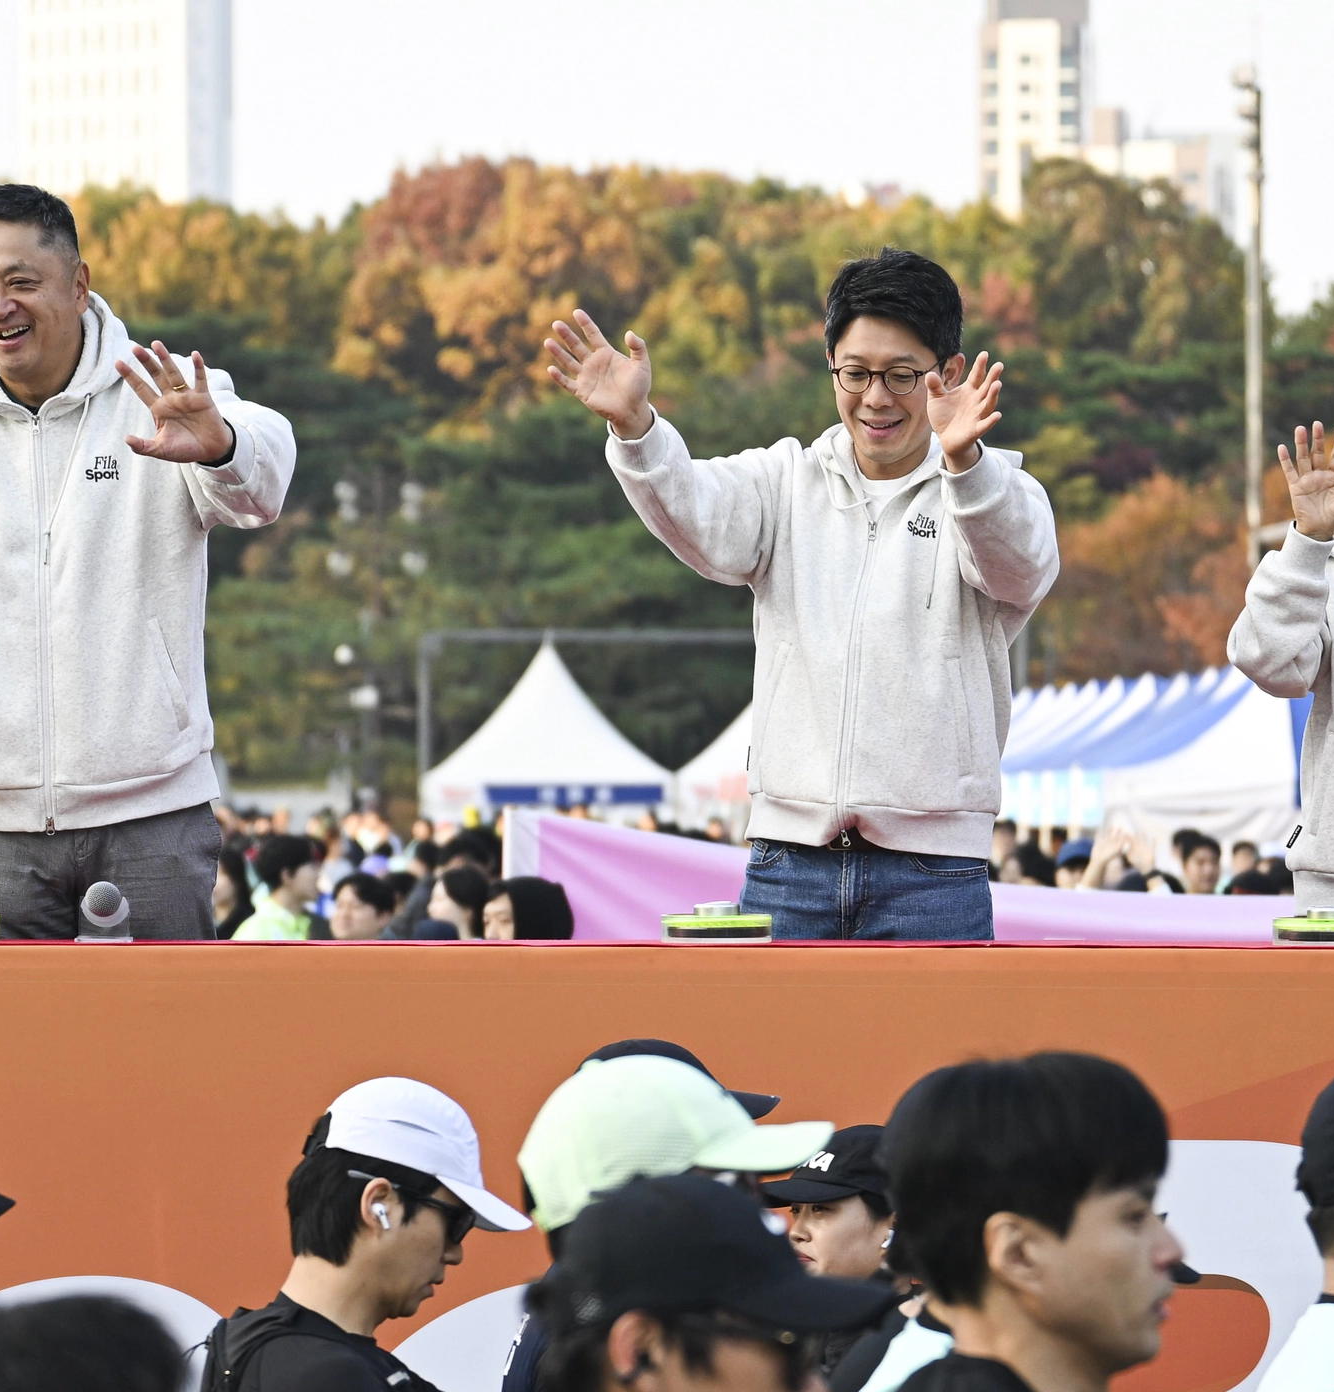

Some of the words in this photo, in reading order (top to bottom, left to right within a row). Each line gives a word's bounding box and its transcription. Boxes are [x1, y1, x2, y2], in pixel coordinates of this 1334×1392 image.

[94, 455, 118, 470] Fila
[85, 469, 120, 482] Sport
[914, 512, 936, 529] Fila
[907, 520, 937, 539] Sport
